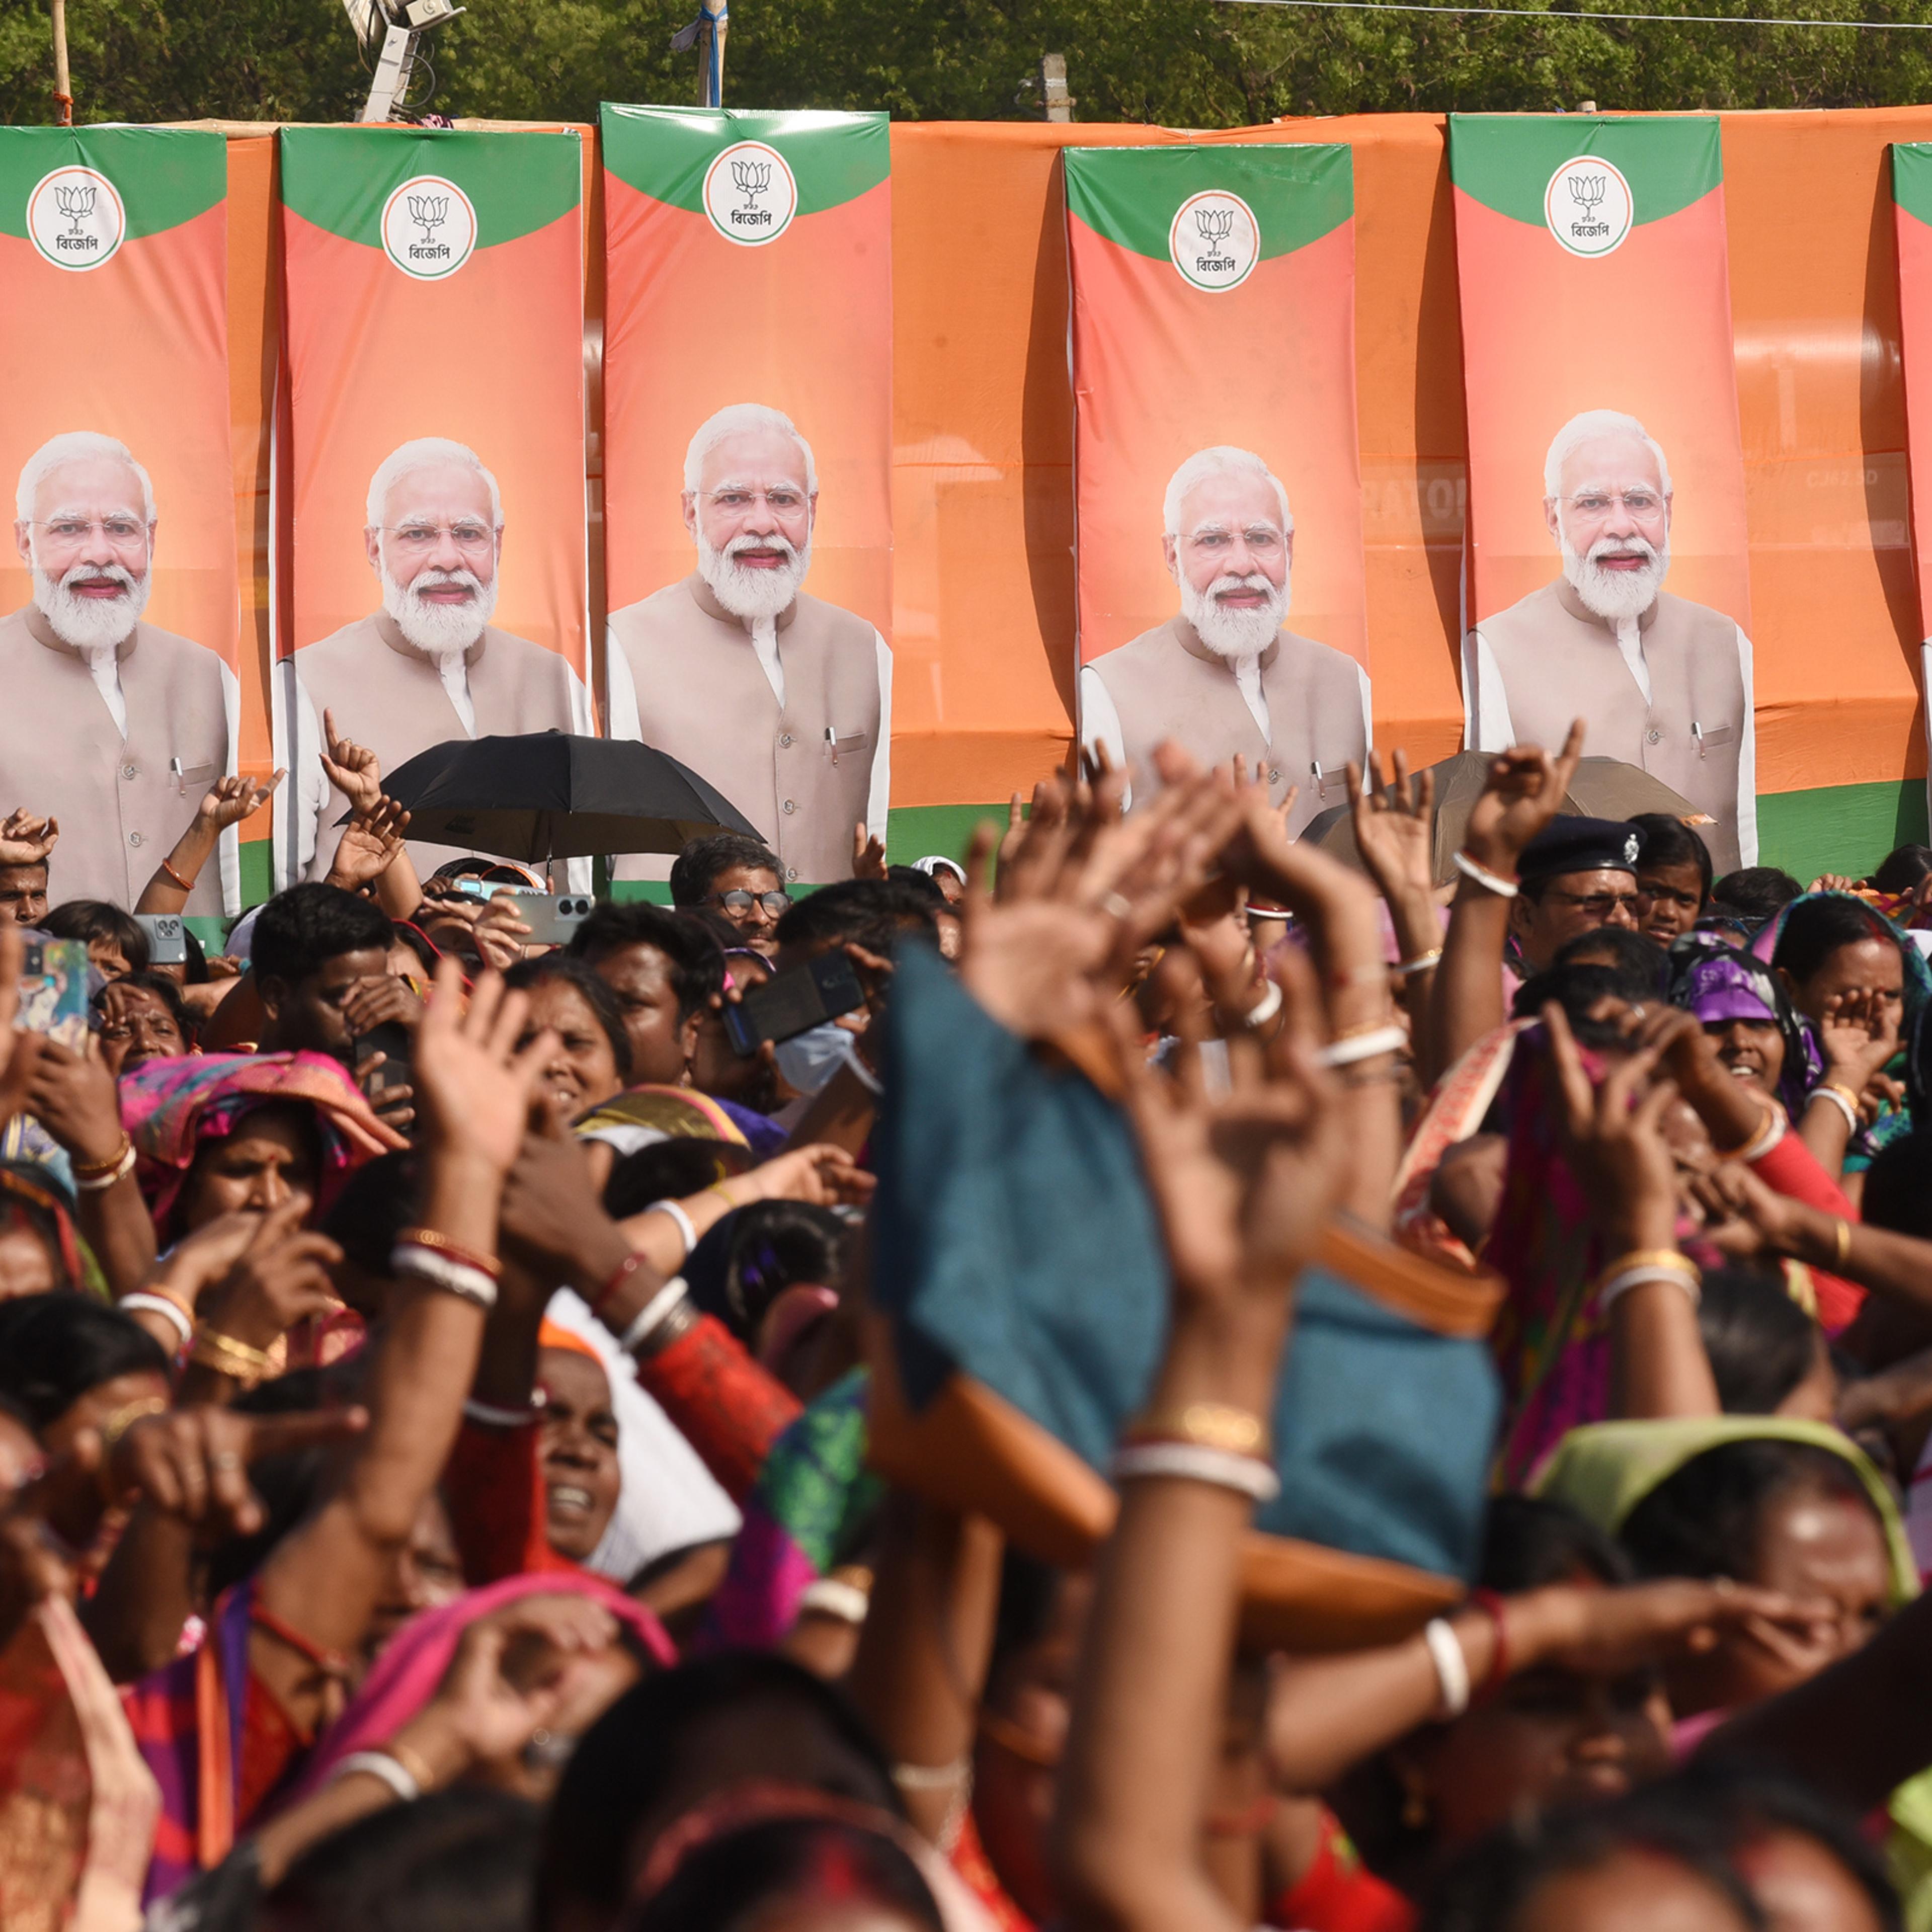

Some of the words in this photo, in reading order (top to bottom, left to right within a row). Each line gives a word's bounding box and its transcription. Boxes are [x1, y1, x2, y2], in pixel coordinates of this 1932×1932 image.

[731, 209, 772, 225] বিজেপি
[1571, 222, 1609, 236] বিজেপি
[56, 235, 98, 250] বিজেপি
[409, 244, 450, 259] বিজেপি
[1196, 257, 1236, 271] বিজেপি
